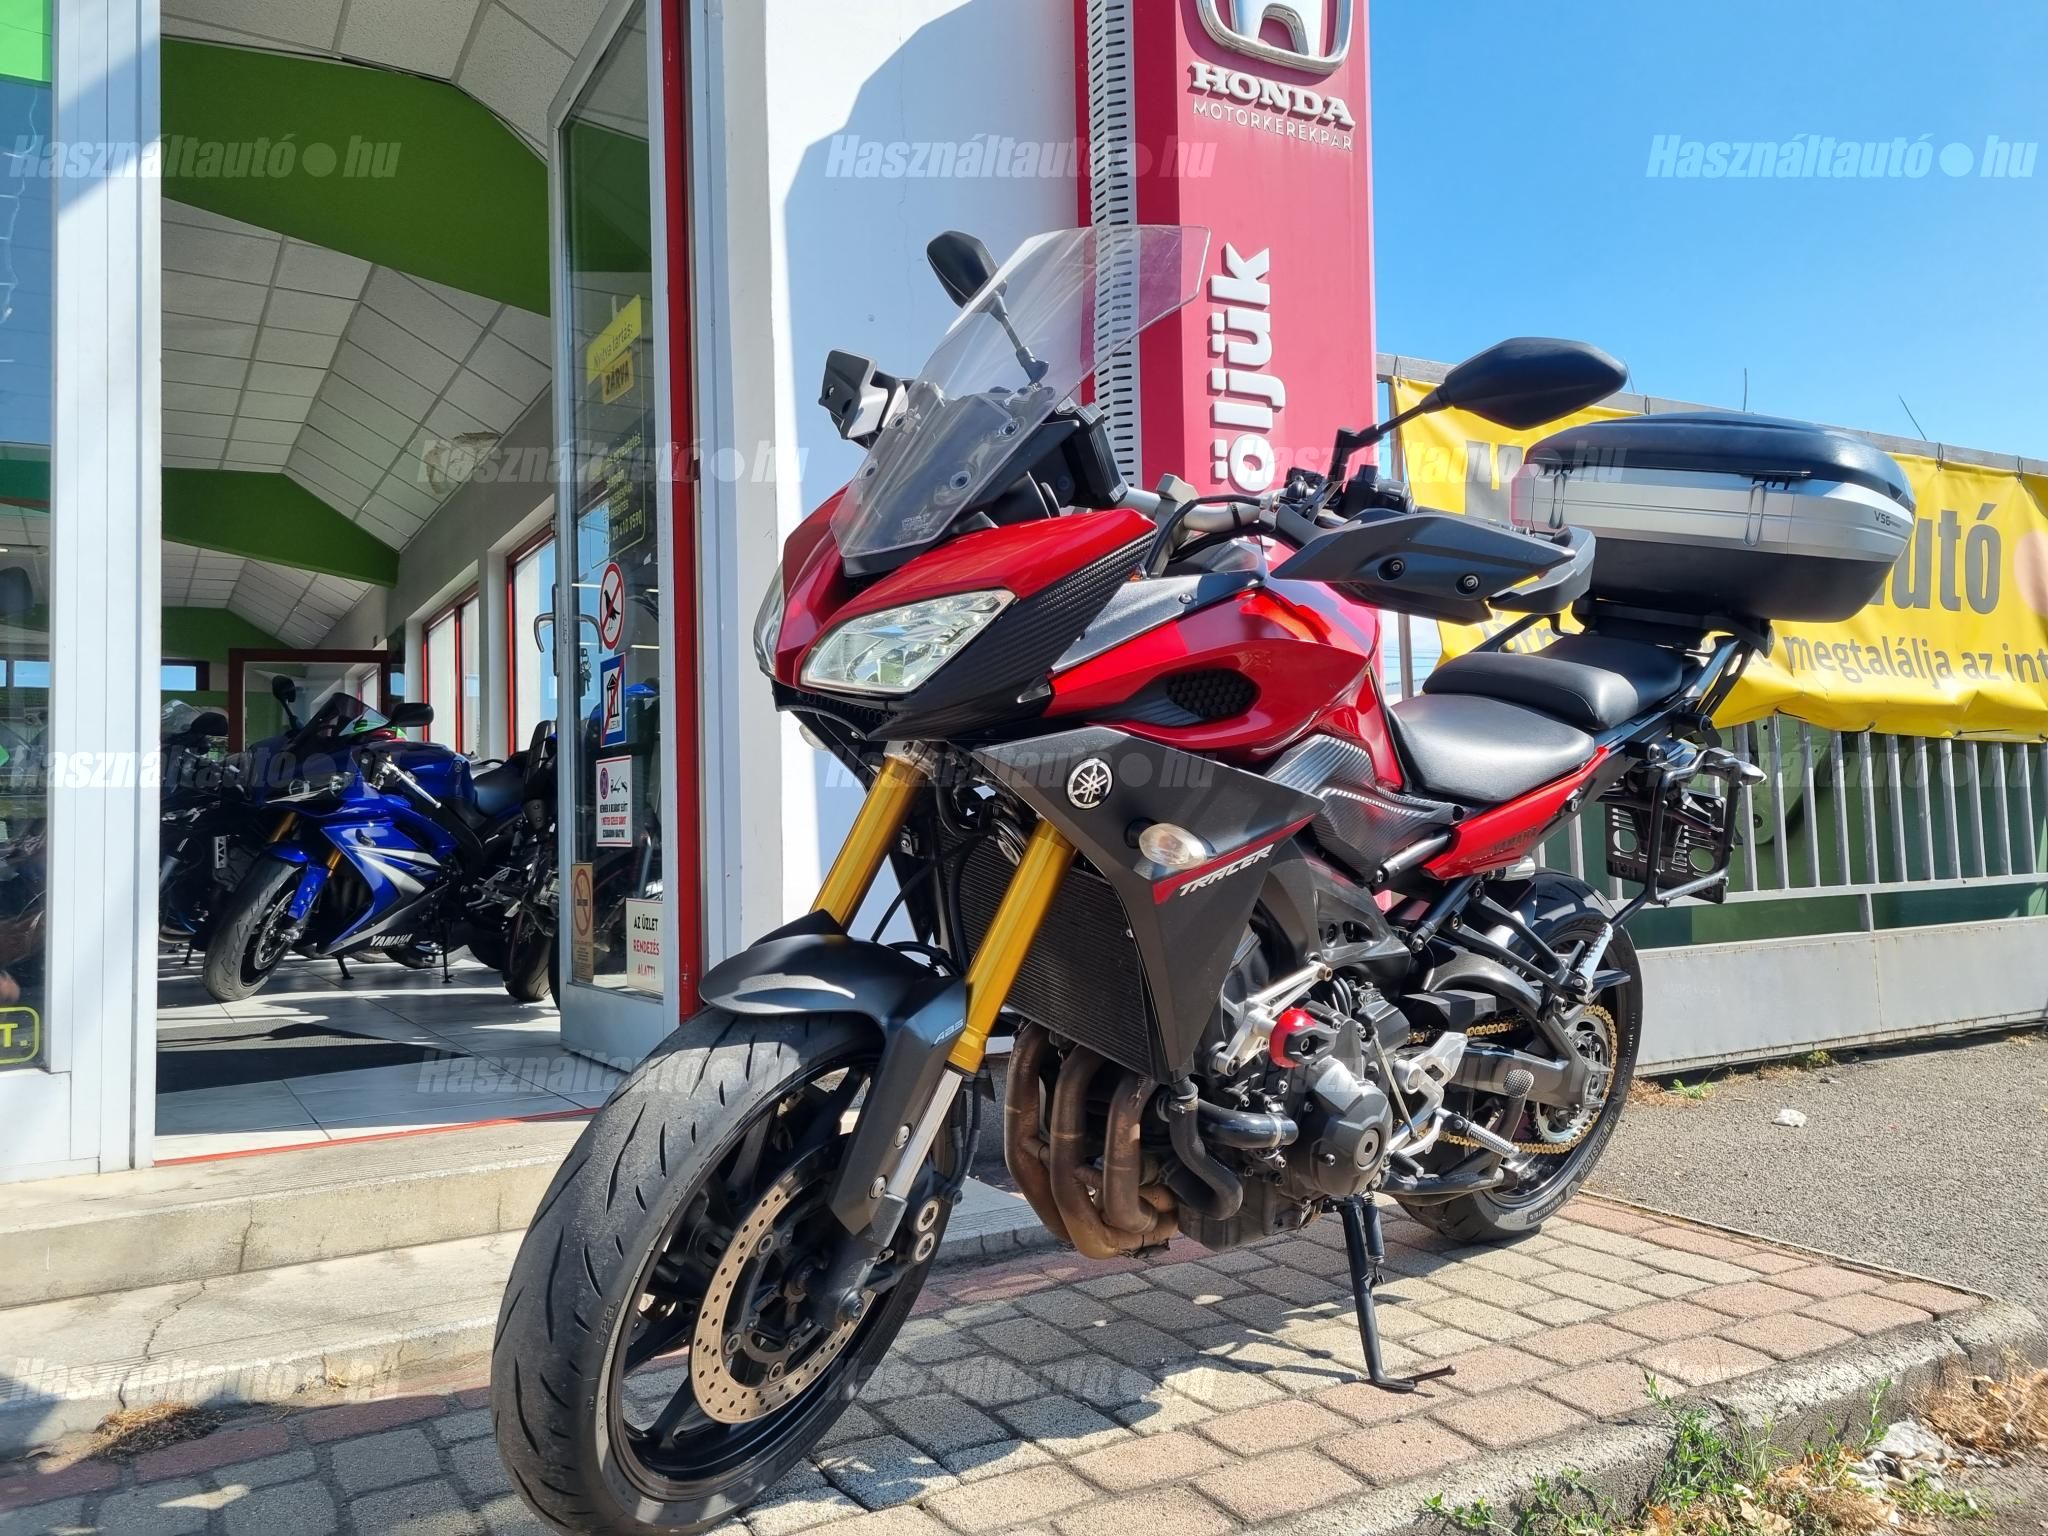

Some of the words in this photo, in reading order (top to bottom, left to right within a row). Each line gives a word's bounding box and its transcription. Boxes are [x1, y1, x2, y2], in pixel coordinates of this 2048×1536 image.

[1190, 61, 1356, 127] HONDA
[1193, 100, 1353, 151] MOTORKERÉKPÁR
[1208, 242, 1286, 492] öljük
[1783, 635, 1954, 690] megtalálja
[1961, 651, 2001, 681] az
[1179, 843, 1275, 897] TRACER
[370, 933, 413, 947] YAMAHA
[632, 937, 660, 956] RENDEZÉS
[633, 915, 641, 930] AZ
